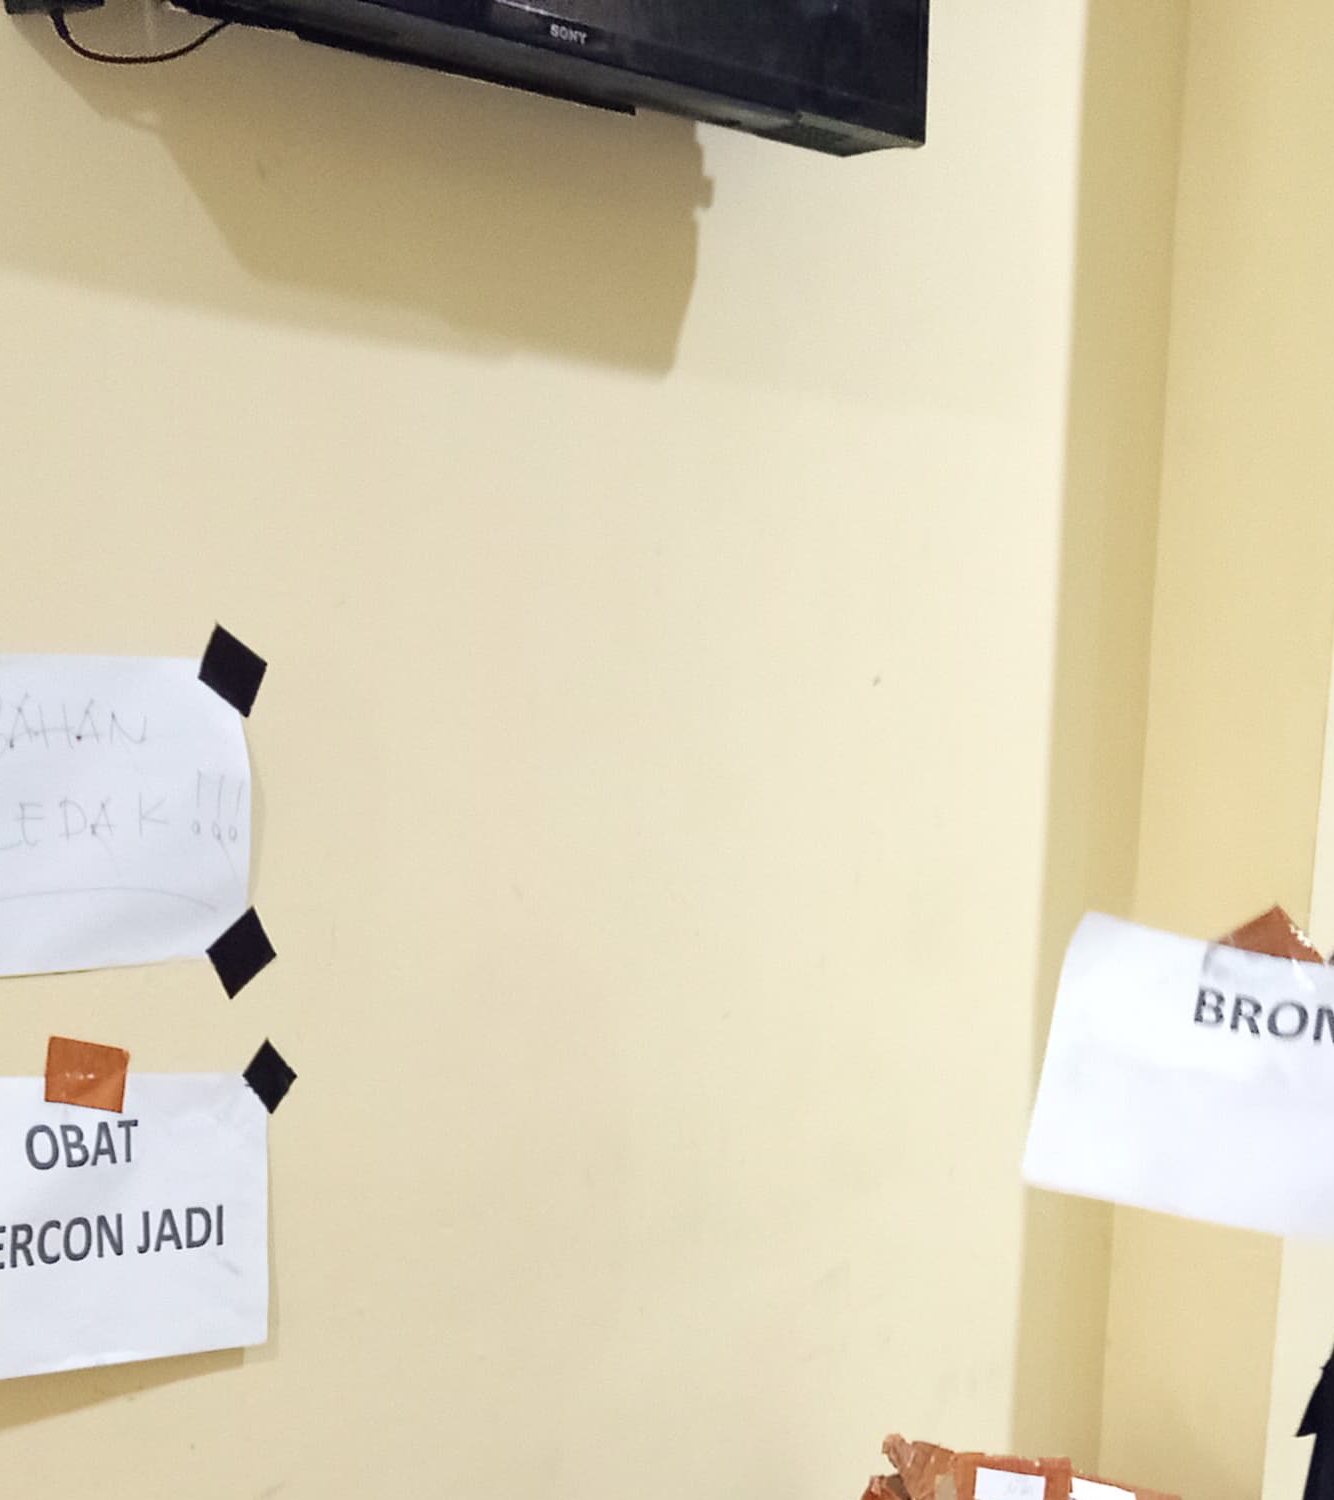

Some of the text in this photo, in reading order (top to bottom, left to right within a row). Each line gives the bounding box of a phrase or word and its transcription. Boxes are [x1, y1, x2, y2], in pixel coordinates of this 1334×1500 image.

[550, 24, 587, 45] SONY
[25, 1119, 139, 1170] OBAT
[137, 1205, 225, 1254] JADI
